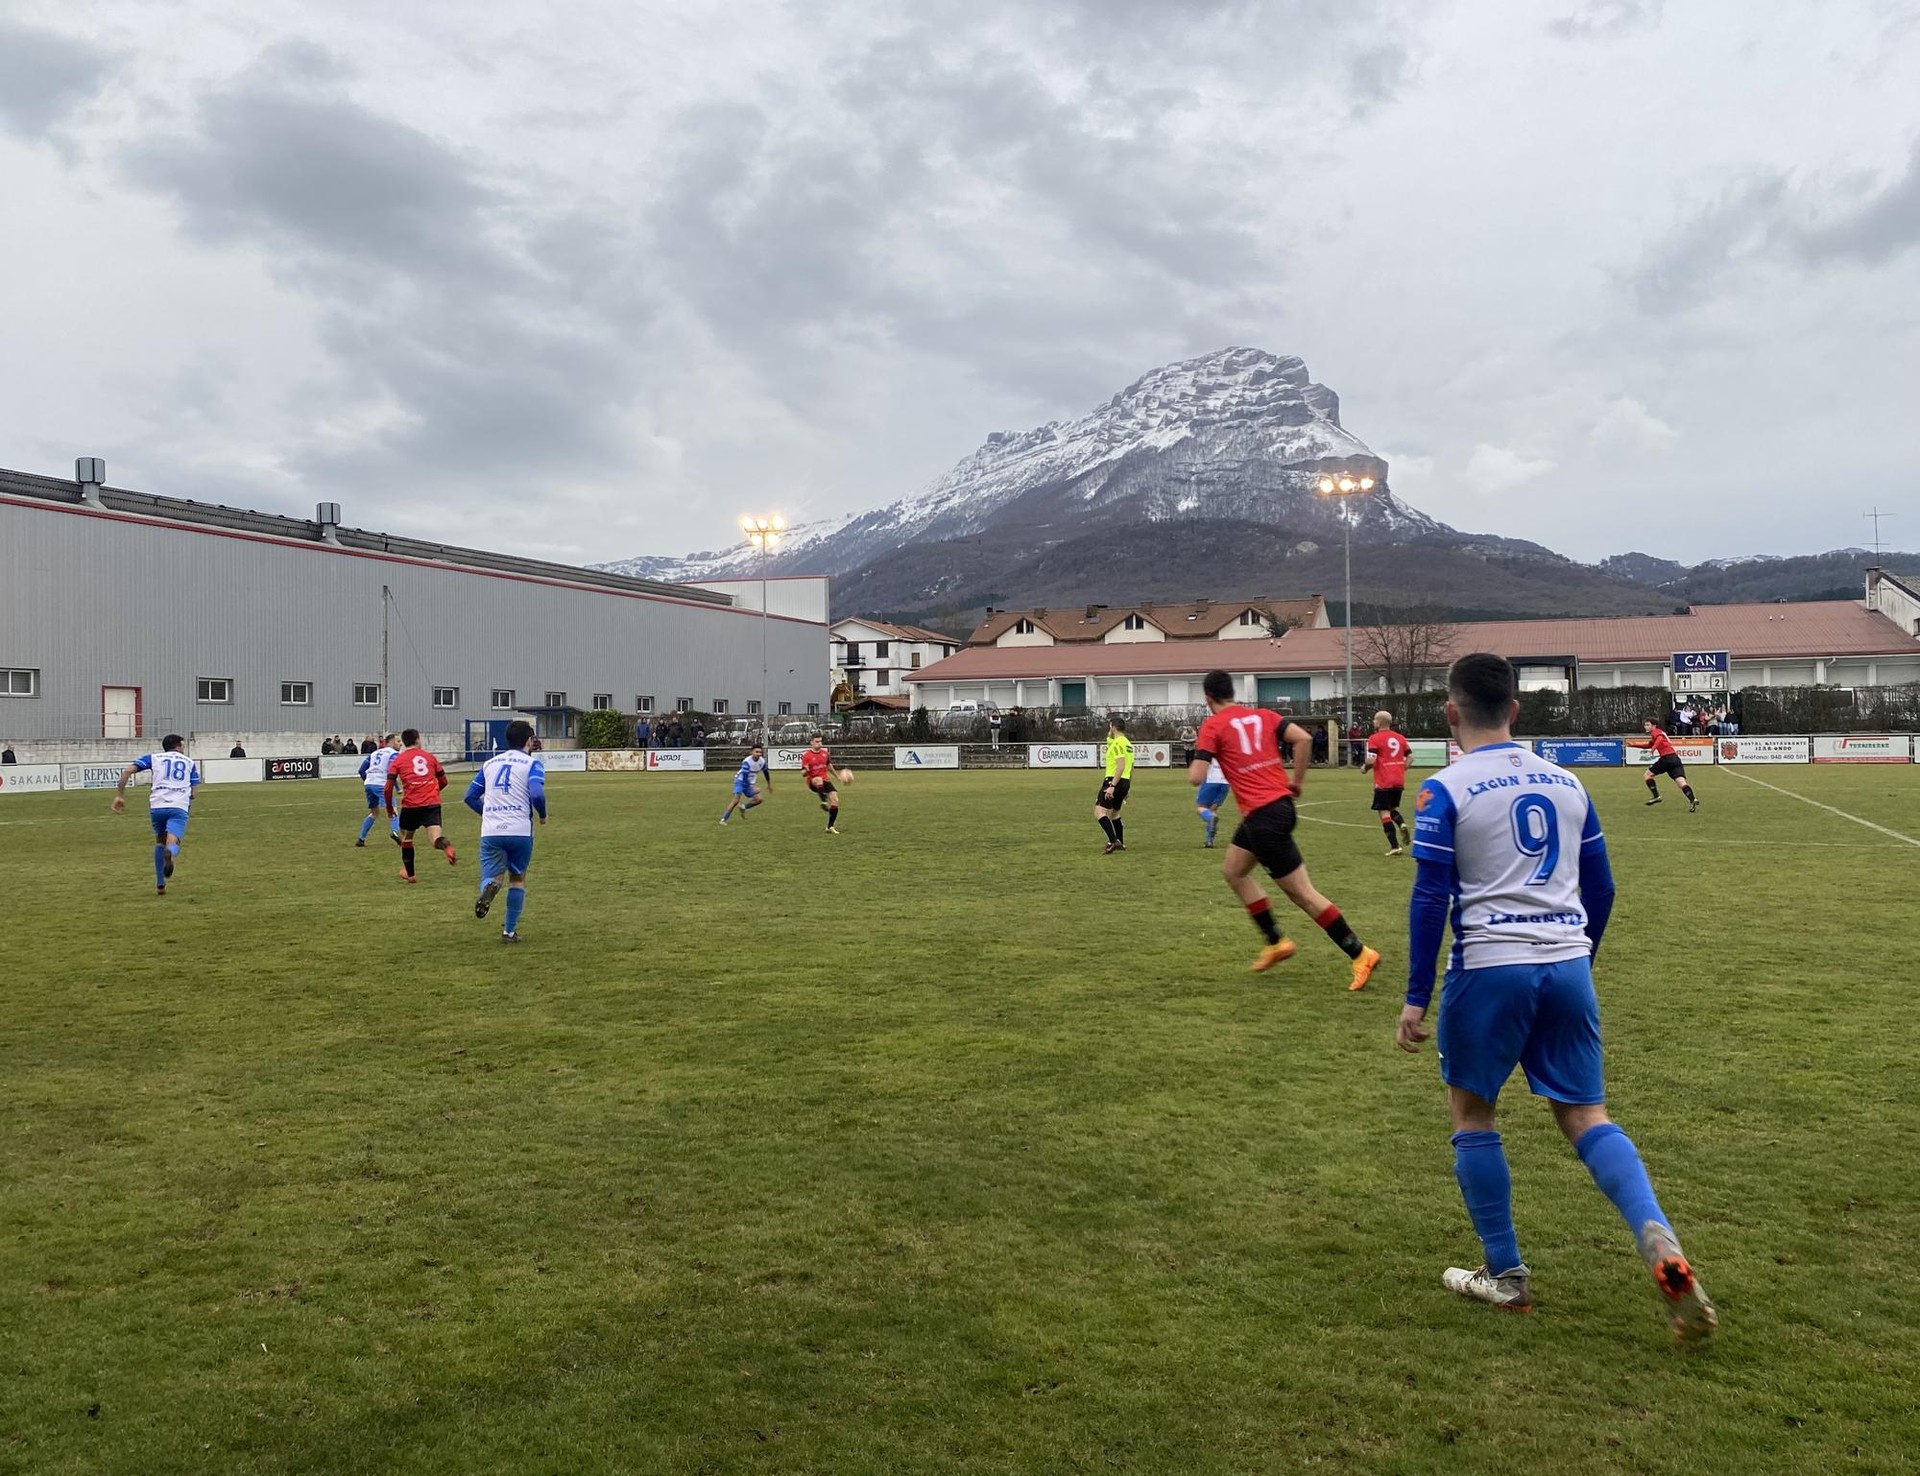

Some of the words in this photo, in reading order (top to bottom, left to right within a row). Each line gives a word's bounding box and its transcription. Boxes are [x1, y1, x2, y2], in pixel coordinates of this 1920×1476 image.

[1684, 654, 1716, 667] CAN
[1682, 680, 1687, 688] 1
[1714, 678, 1720, 687] 2
[1229, 714, 1263, 756] 17
[1042, 750, 1089, 760] BARRANQUESA
[1387, 737, 1400, 757] 9
[162, 759, 186, 781] 18
[412, 755, 429, 776] 8
[9, 774, 59, 786] SAKANA
[493, 763, 513, 795] 4
[1467, 775, 1520, 796] LAGUN
[1509, 793, 1560, 886] 9
